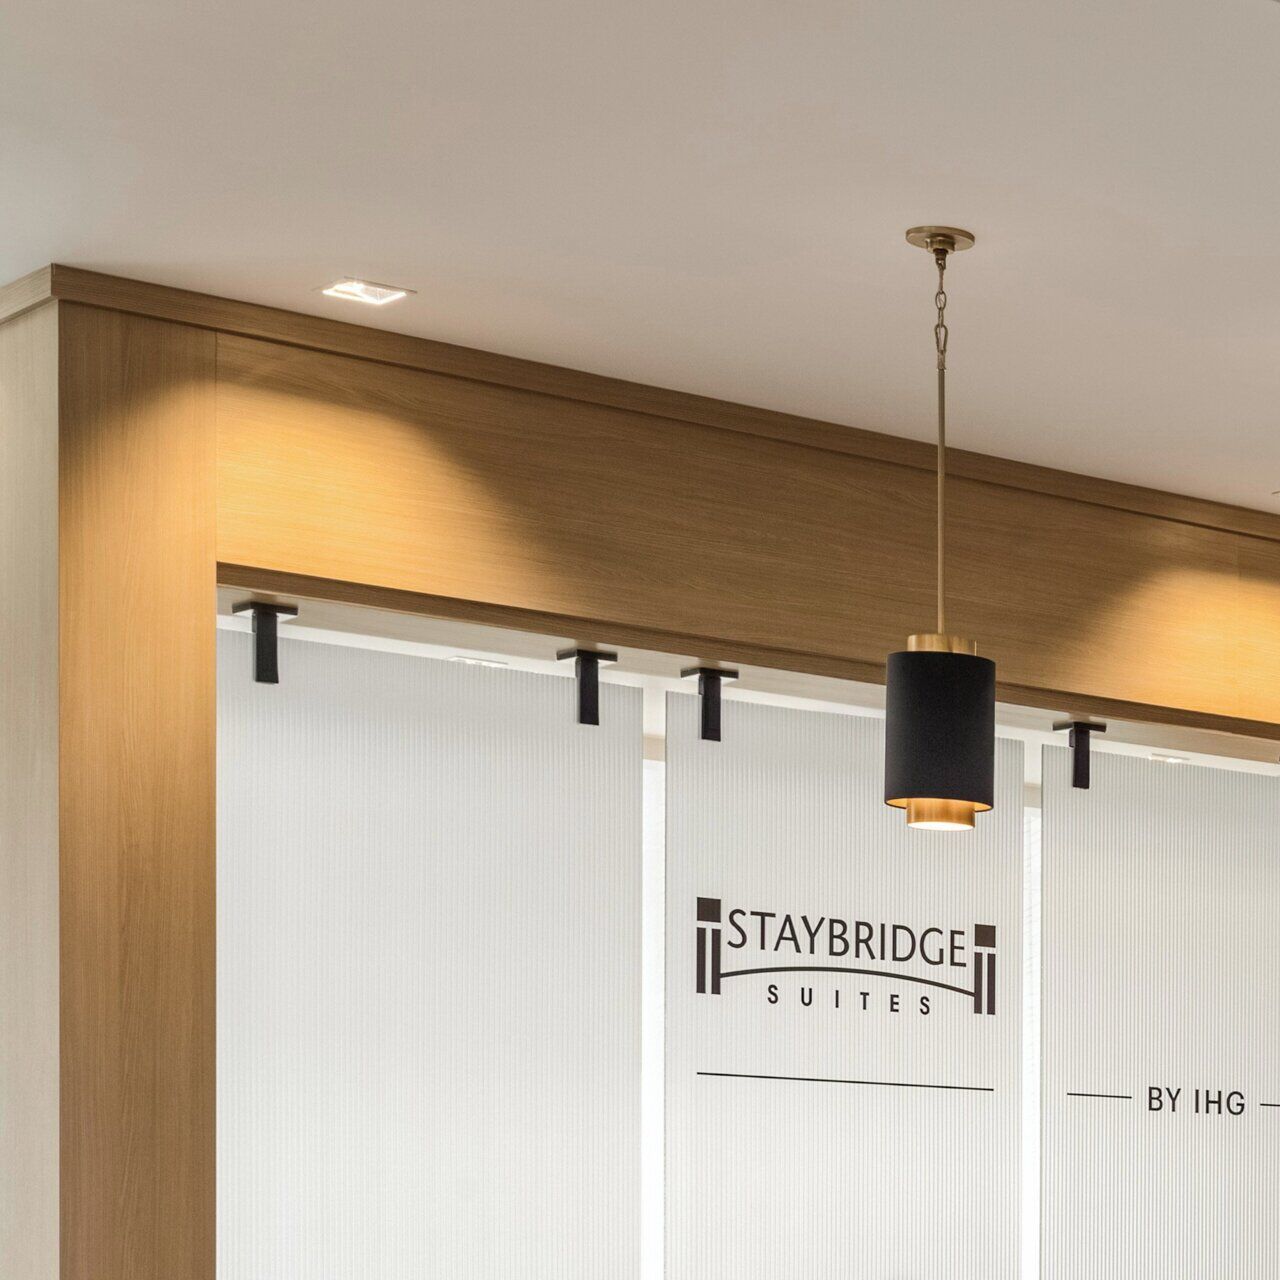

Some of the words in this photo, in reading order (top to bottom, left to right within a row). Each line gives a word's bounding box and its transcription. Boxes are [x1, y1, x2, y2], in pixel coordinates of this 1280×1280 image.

[727, 908, 968, 969] STAYBRIDGE
[767, 984, 930, 1016] SUITES
[1148, 1086, 1182, 1113] BY
[1194, 1089, 1246, 1117] IHG
